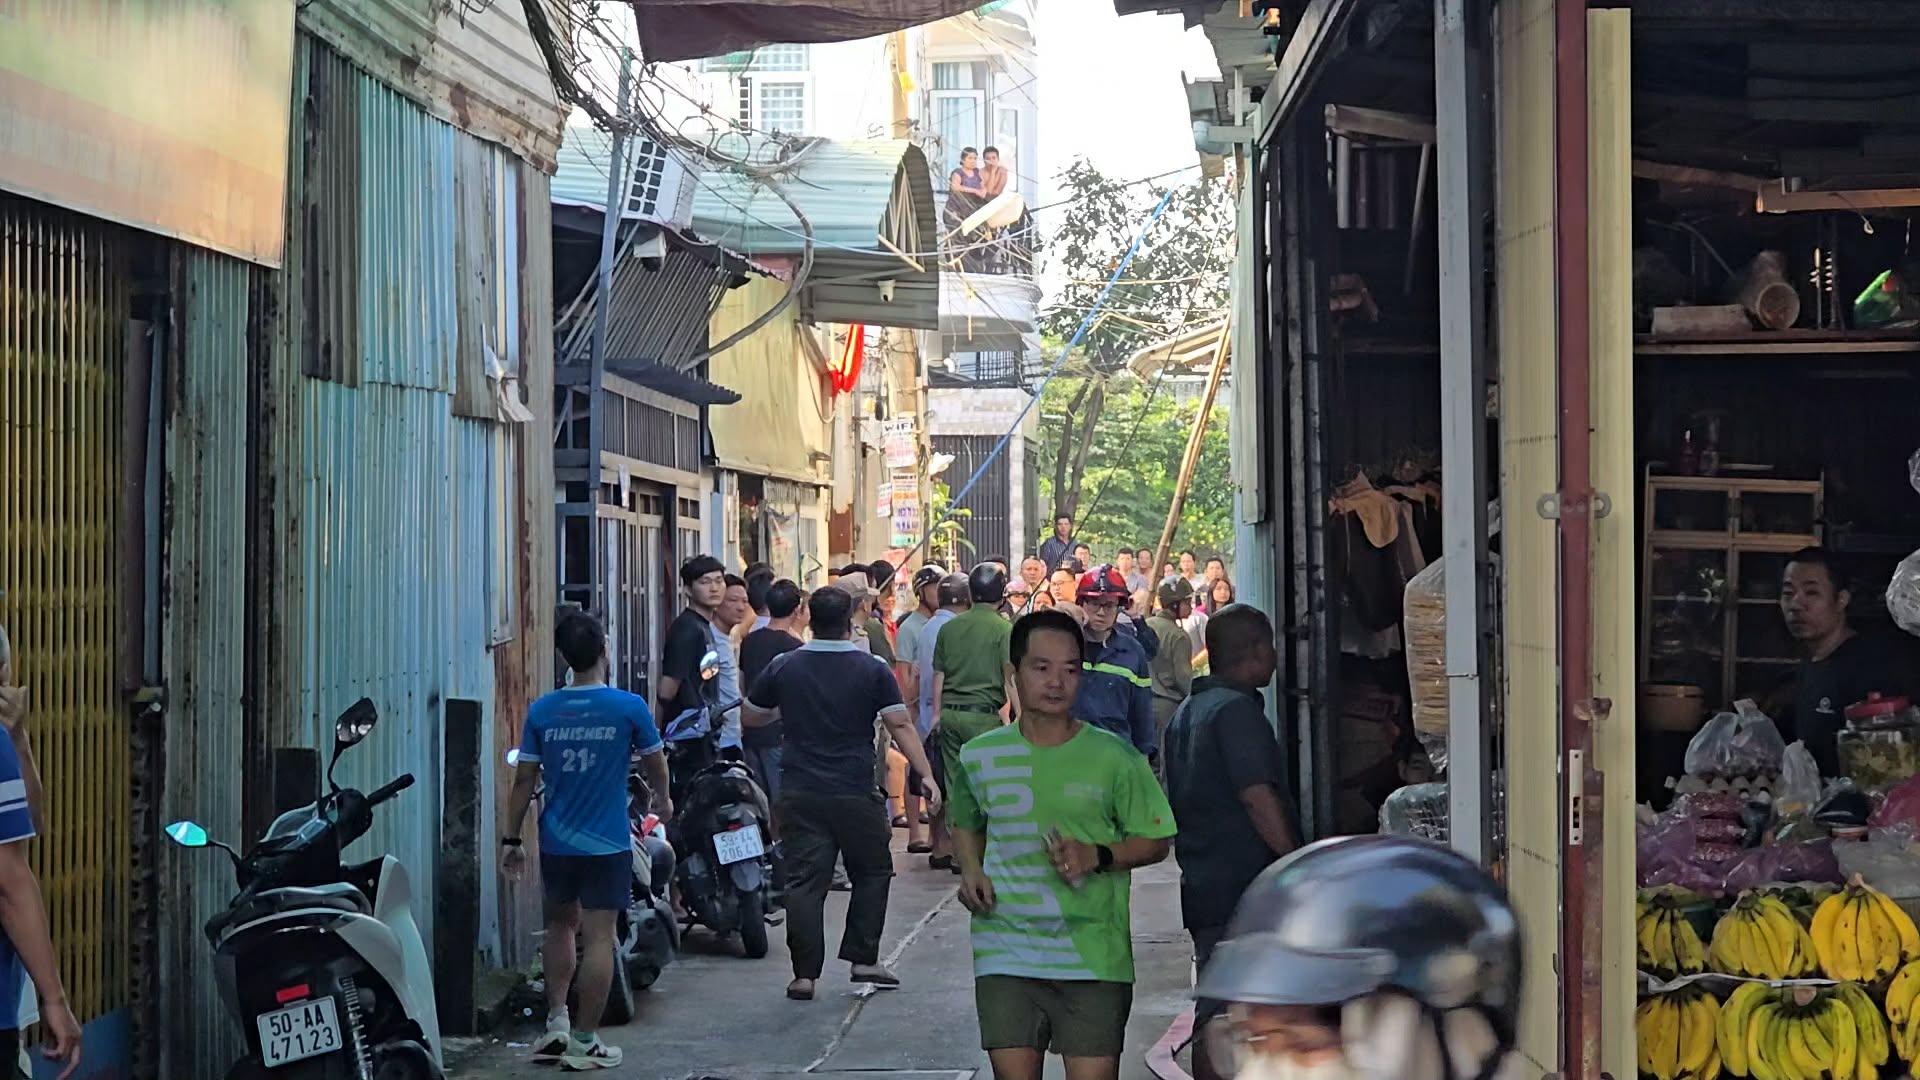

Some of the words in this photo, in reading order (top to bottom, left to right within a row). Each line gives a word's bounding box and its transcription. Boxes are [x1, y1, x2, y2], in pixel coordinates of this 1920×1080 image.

[544, 726, 617, 743] FINISHER
[269, 1004, 324, 1036] 50-AA
[271, 1027, 334, 1061] 471.23
